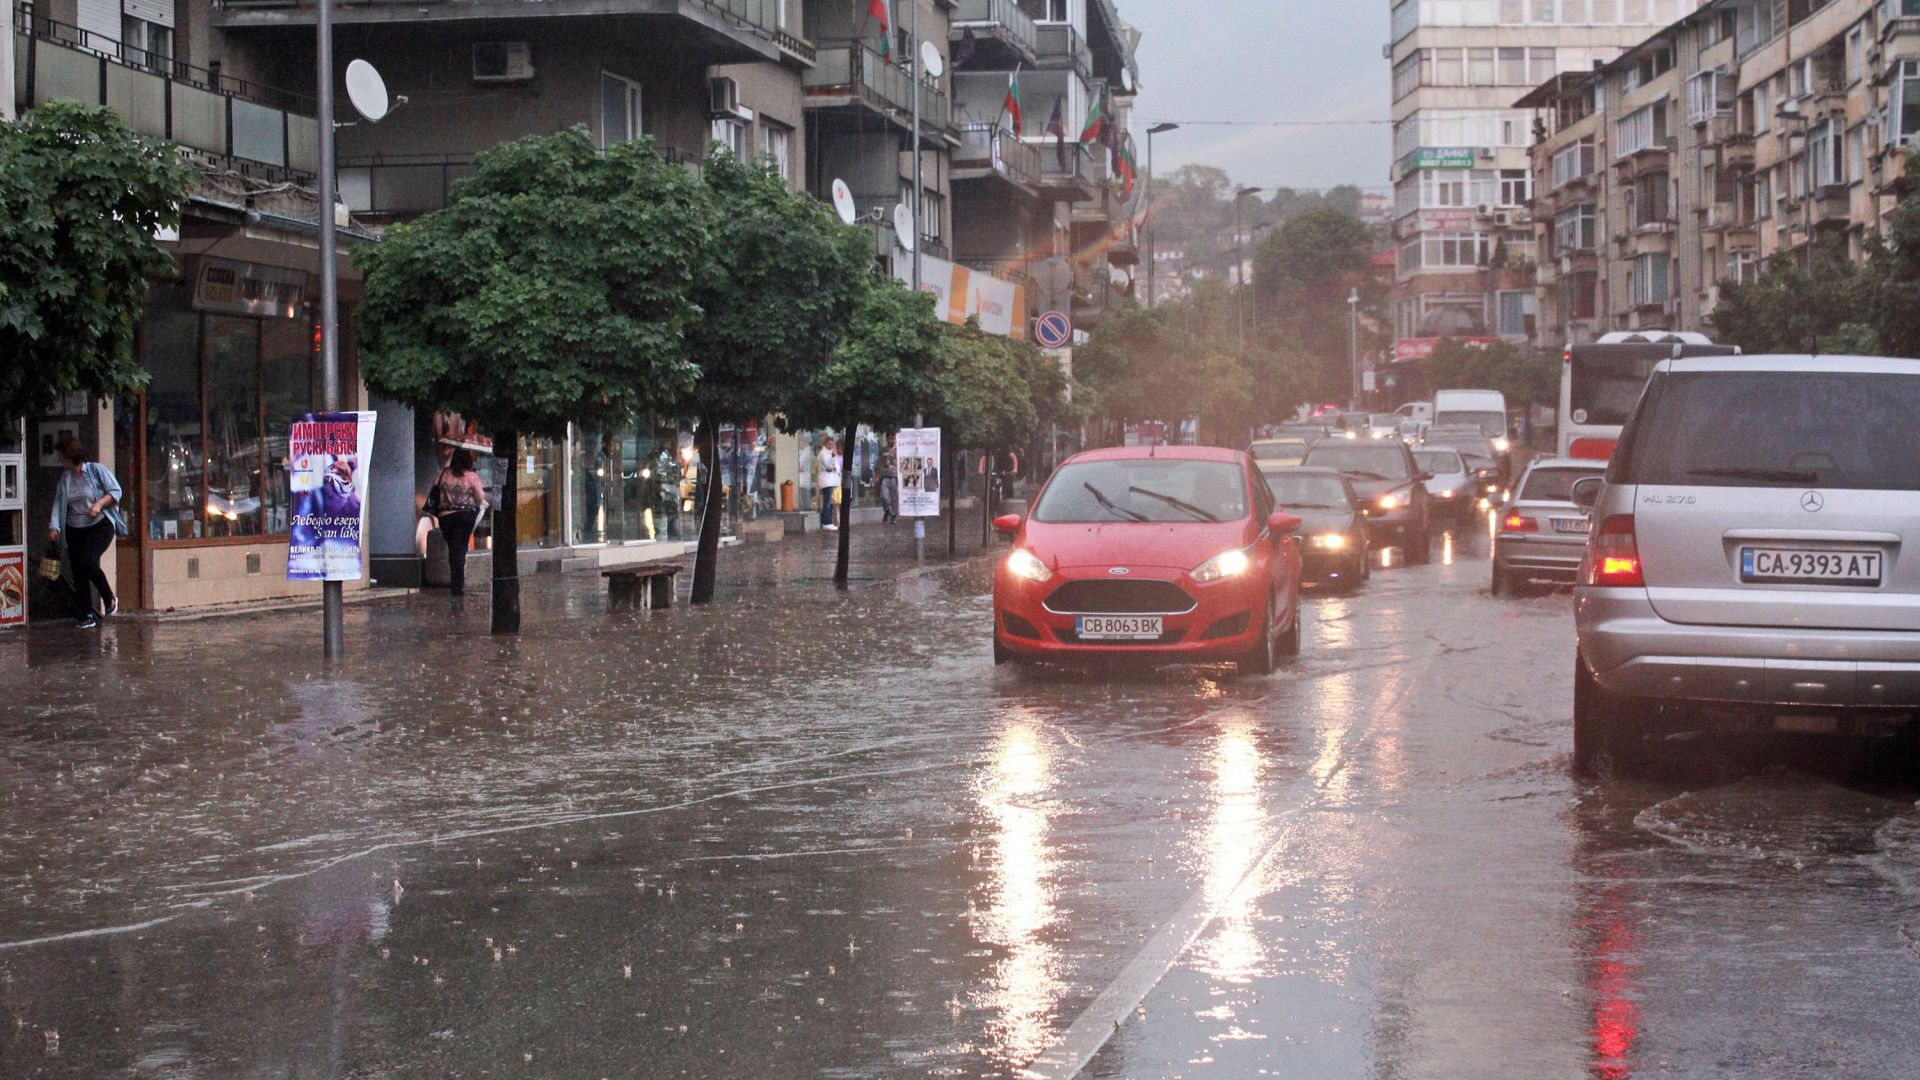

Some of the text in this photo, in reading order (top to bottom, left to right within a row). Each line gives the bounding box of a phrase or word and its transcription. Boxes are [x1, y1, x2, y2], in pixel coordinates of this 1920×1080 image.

[314, 527, 337, 539] San
[1790, 554, 1843, 575] 9393
[1847, 555, 1876, 576] AT
[1084, 619, 1159, 633] CB 8063 BK
